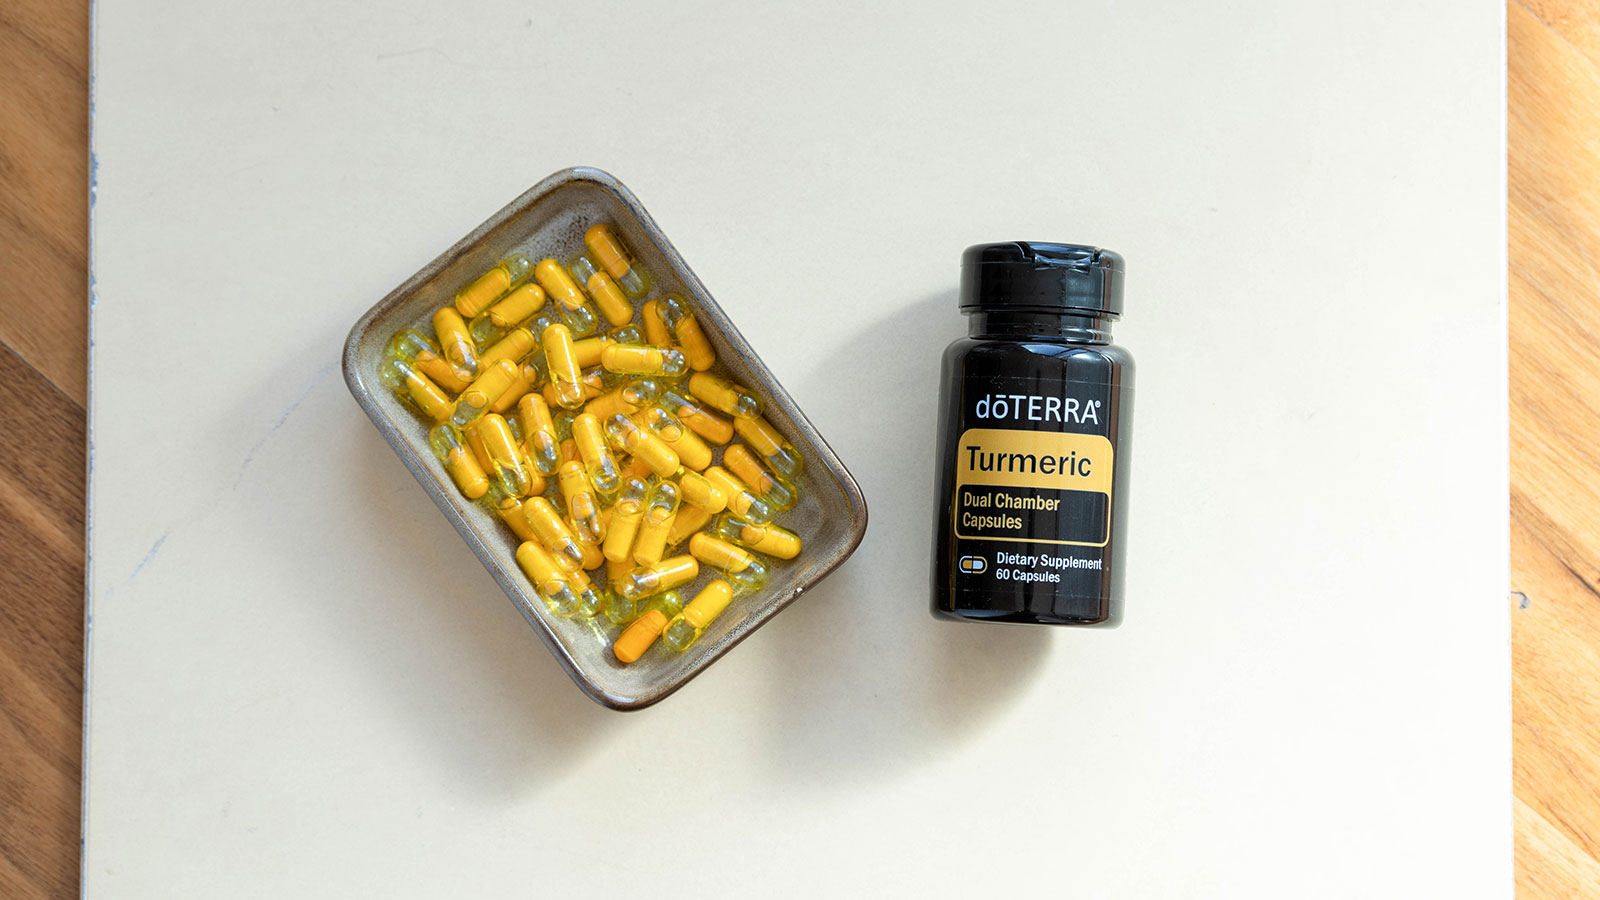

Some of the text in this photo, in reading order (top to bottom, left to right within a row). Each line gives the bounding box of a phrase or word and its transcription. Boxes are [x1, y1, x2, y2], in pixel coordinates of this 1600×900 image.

[966, 446, 1091, 477] Turmeric
[964, 492, 1060, 511] Dual Chamber
[963, 512, 1023, 530] Capsules
[996, 552, 1102, 570] Dietary Supplement
[996, 569, 1060, 583] 60 Capsules
